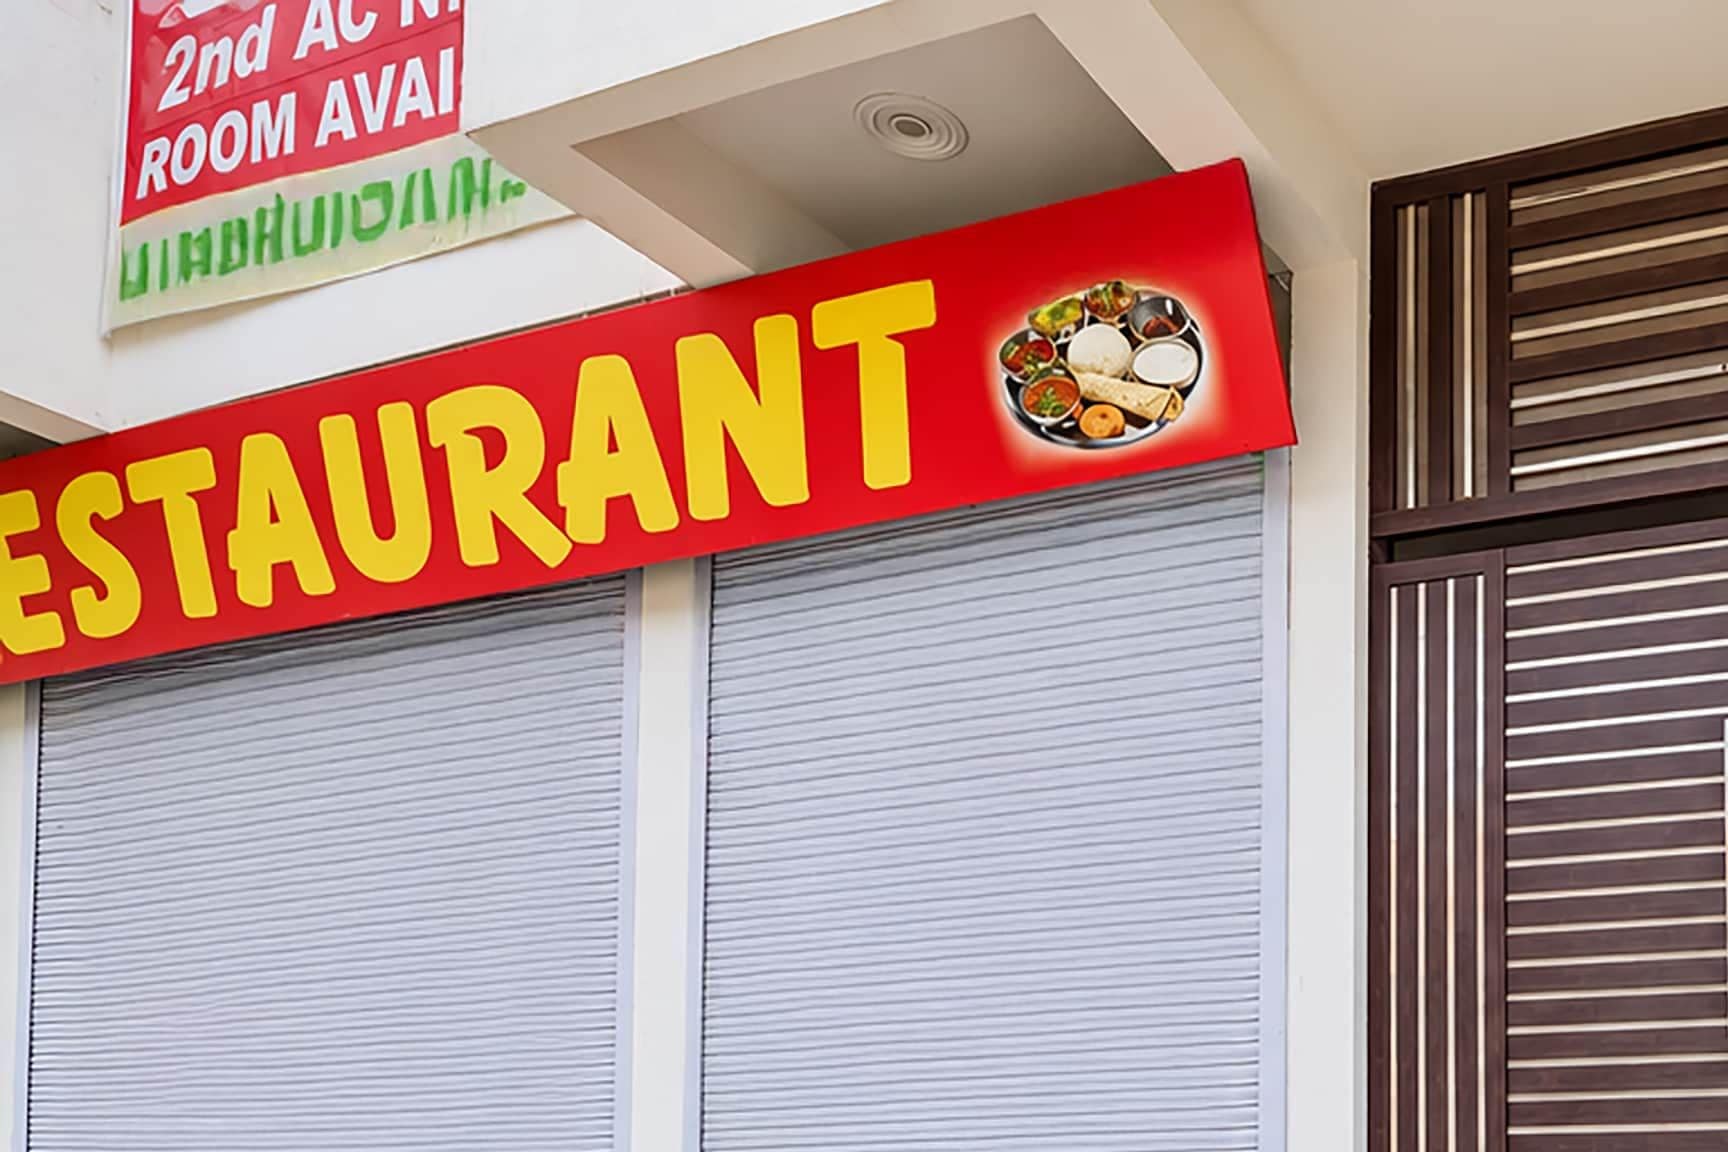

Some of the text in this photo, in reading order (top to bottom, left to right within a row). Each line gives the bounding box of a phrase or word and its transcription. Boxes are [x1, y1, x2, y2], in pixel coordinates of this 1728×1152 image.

[136, 47, 454, 200] ROOM AVAI
[157, 0, 378, 112] 2nd AC
[0, 280, 936, 656] ESTAURANT
